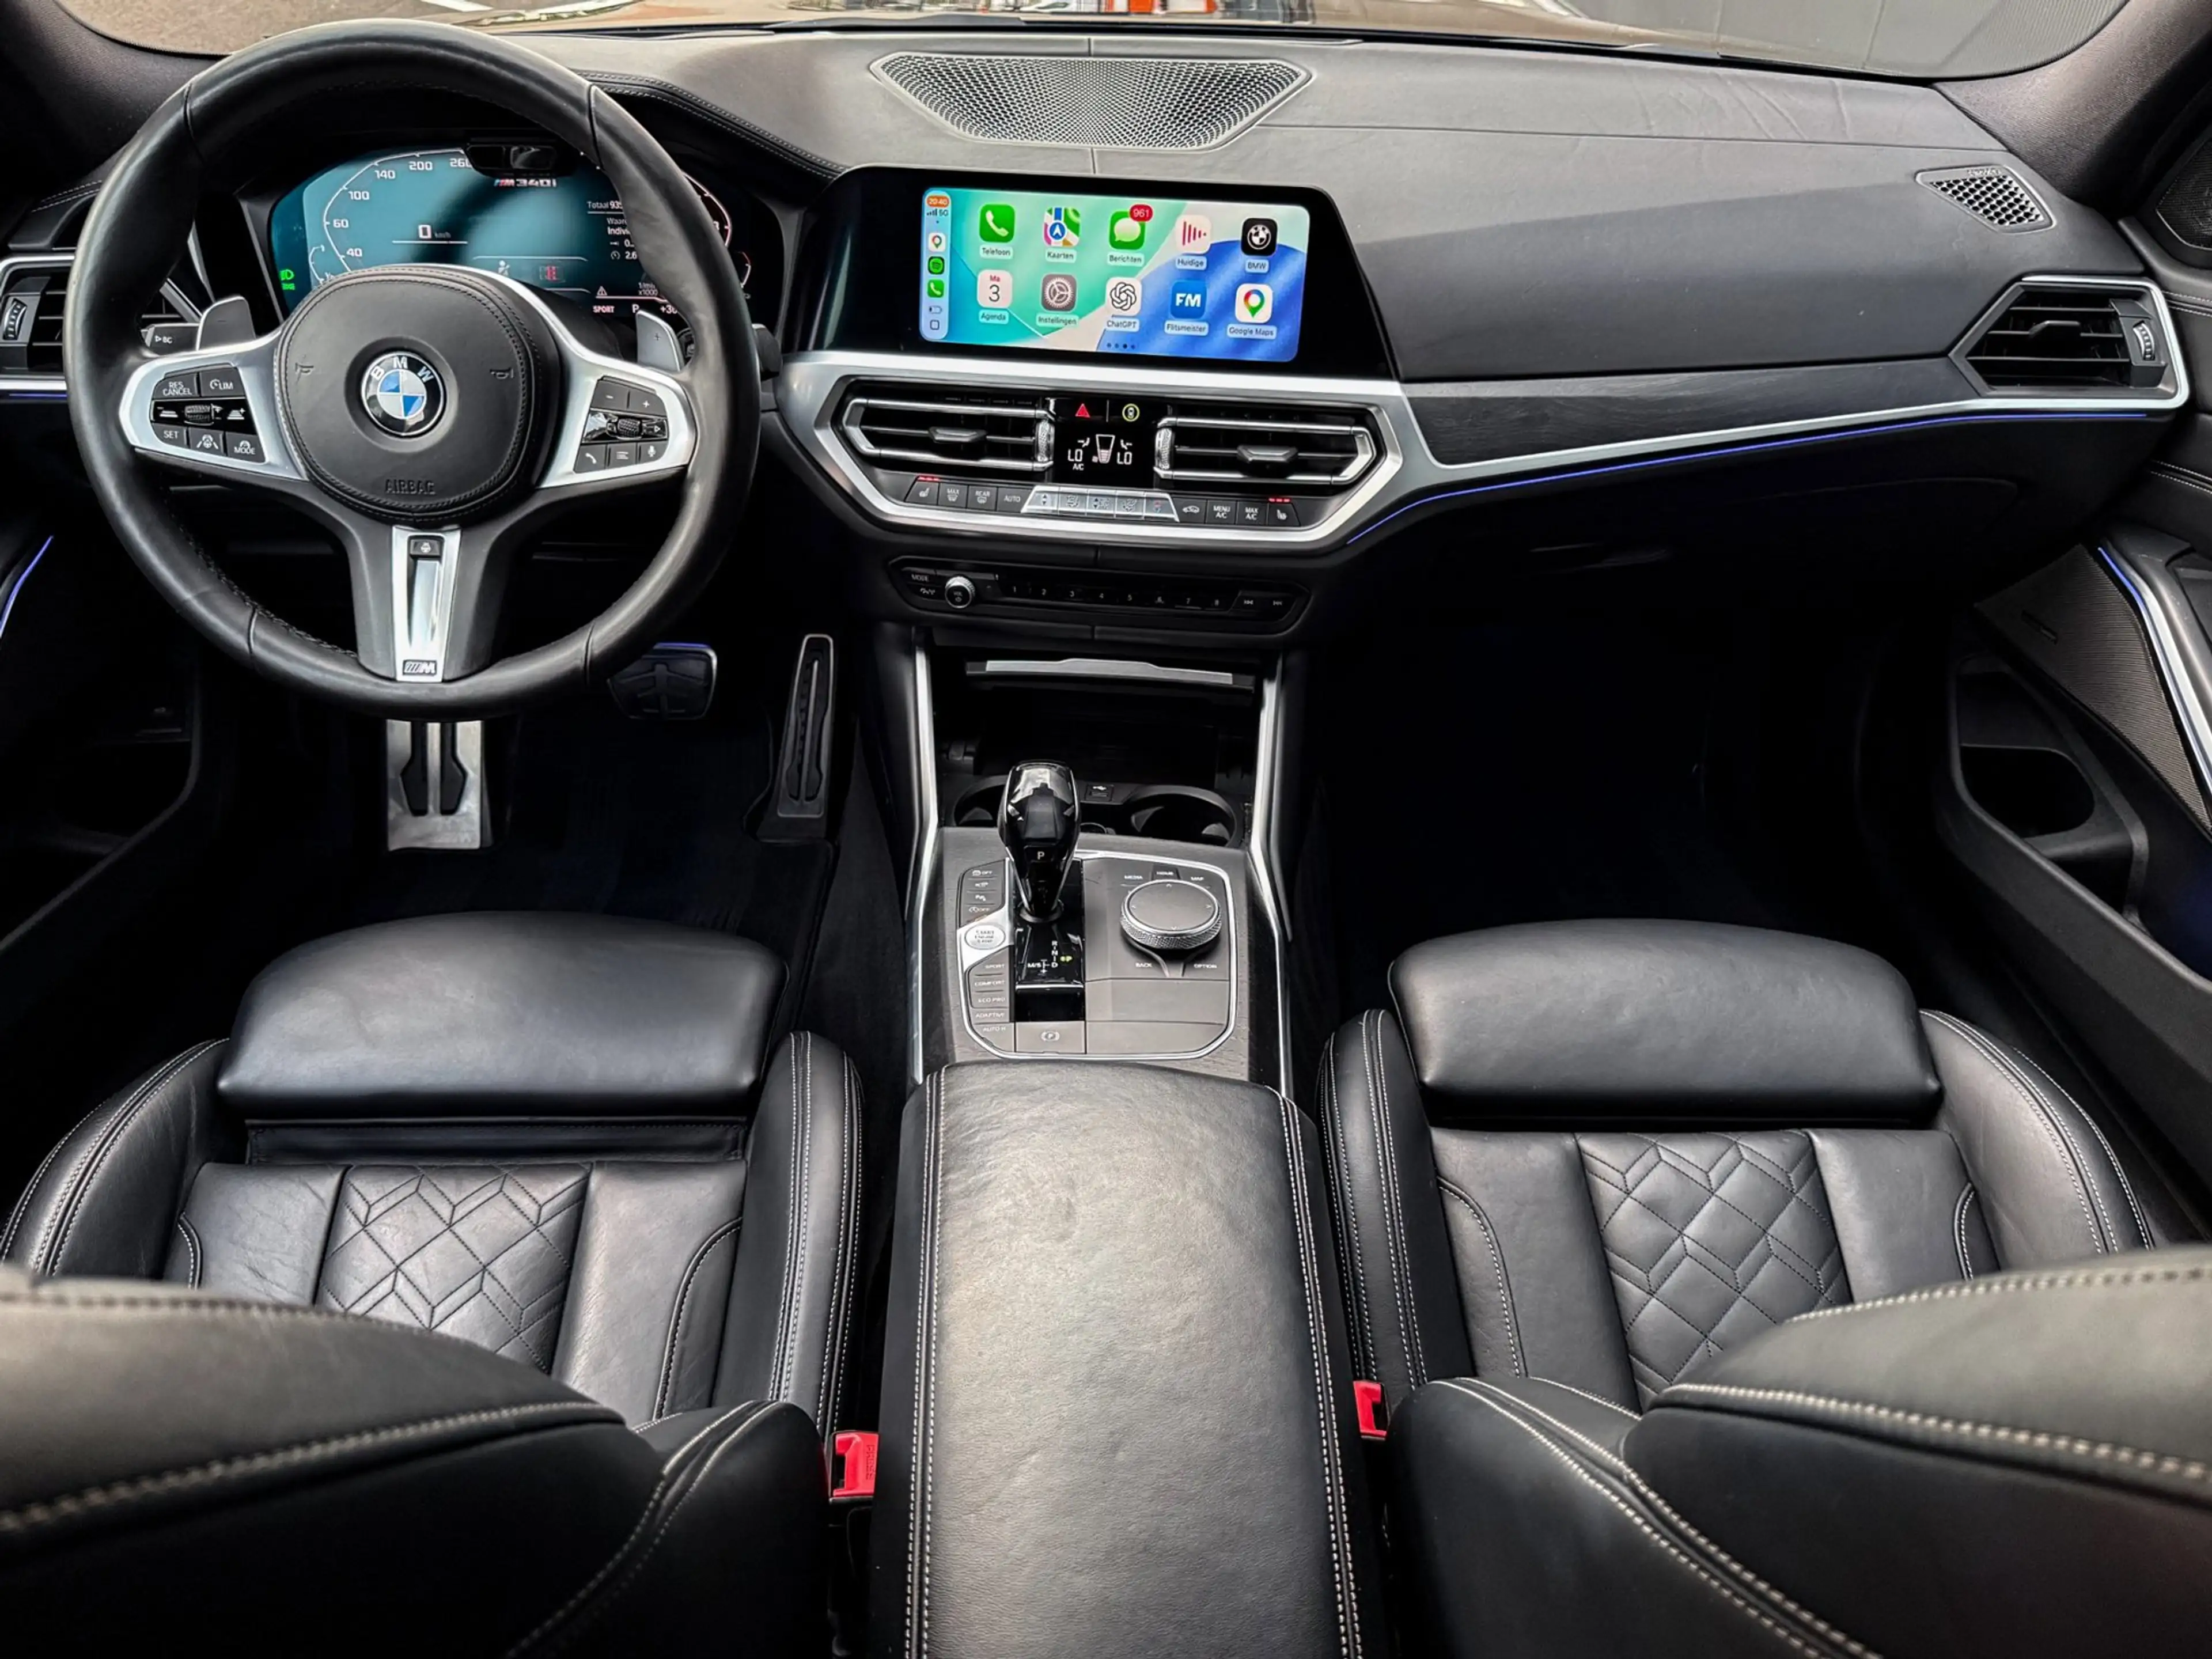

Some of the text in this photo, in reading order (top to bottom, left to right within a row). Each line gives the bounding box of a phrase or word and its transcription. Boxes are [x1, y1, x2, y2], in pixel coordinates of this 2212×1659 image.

[409, 161, 433, 171] 200
[374, 170, 396, 179] 140
[348, 191, 370, 200] 100
[587, 201, 609, 209] Totaal
[1132, 209, 1150, 217] 961
[333, 219, 349, 228] 60
[418, 225, 432, 239] 0
[347, 248, 362, 257] 40
[982, 247, 1010, 256] Telefoon
[1047, 252, 1074, 260] Kaarten
[1109, 255, 1142, 263] Berichten
[1177, 259, 1205, 267] Huidige
[988, 284, 1000, 302] 3
[1175, 293, 1202, 308] FM
[981, 313, 1006, 322] Agenda
[1038, 316, 1077, 325] Instellingen
[1107, 320, 1137, 329] ChatGPT
[1166, 324, 1206, 332] Flitsmeister
[1229, 327, 1253, 336] Google
[370, 355, 434, 383] BMW
[219, 382, 234, 390] LIM
[162, 387, 192, 396] CANCEL
[164, 430, 180, 440] SET
[234, 446, 256, 455] MODE
[1067, 448, 1083, 462] LO
[1116, 451, 1132, 465] LO
[385, 479, 436, 495] AIRBAG
[1037, 851, 1045, 860] P
[866, 1444, 876, 1480] PRESS
